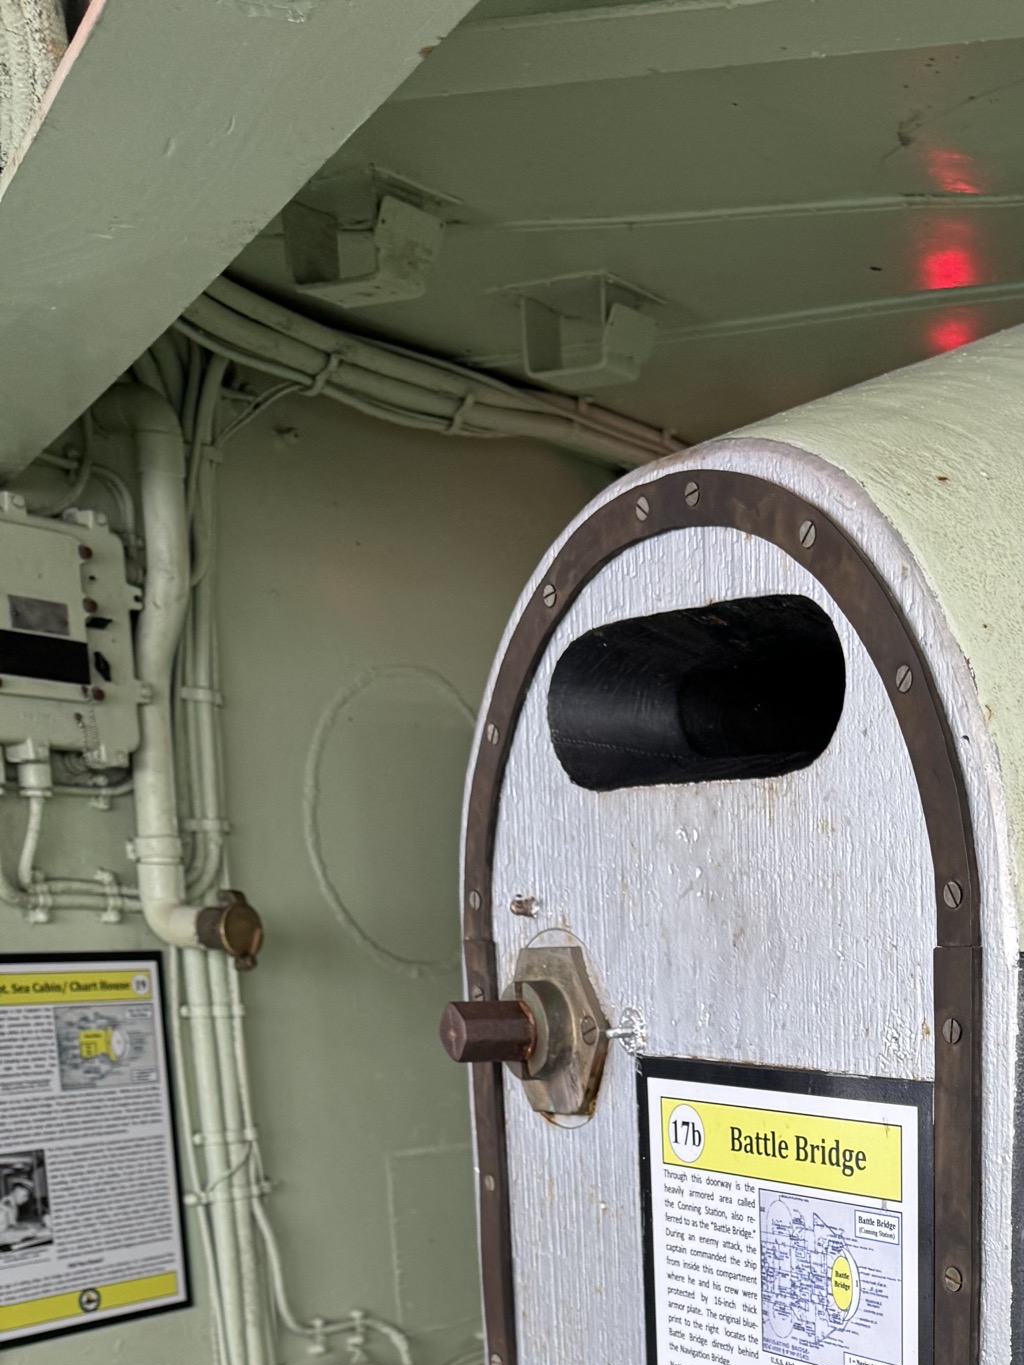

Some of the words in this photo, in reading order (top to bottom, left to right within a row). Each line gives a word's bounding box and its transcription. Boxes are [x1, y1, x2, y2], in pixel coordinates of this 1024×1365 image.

[672, 1119, 701, 1147] 17b
[729, 1126, 788, 1159] Battle
[794, 1134, 866, 1177] Bridge
[663, 1168, 687, 1183] Through
[690, 1173, 702, 1184] this
[705, 1175, 732, 1191] doorway
[743, 1182, 755, 1193] the
[663, 1183, 684, 1197] heavily
[688, 1189, 714, 1201] armored
[718, 1195, 732, 1204] area
[737, 1197, 755, 1209] called
[664, 1198, 674, 1209] the
[677, 1200, 702, 1216] Conning
[704, 1205, 728, 1220] Station,
[730, 1210, 743, 1222] also
[746, 1215, 756, 1224] re-
[664, 1212, 682, 1224] ferred
[698, 1219, 709, 1230] the
[858, 1215, 875, 1226] Battle
[876, 1218, 896, 1231] Bridge
[665, 1227, 685, 1241] During
[698, 1236, 719, 1248] enemy
[722, 1240, 742, 1253] attack,
[745, 1243, 757, 1255] the
[665, 1243, 687, 1254] captain
[689, 1248, 726, 1263] commanded
[729, 1255, 740, 1266] the
[743, 1258, 757, 1271] ship
[666, 1255, 680, 1267] from
[682, 1259, 700, 1272] inside
[702, 1264, 714, 1275] this
[715, 1268, 757, 1285] compartment
[666, 1271, 685, 1283] where
[698, 1279, 709, 1289] and
[712, 1280, 721, 1291] his
[723, 1285, 739, 1295] crew
[741, 1289, 757, 1300] were
[834, 1270, 849, 1280] Battle
[834, 1280, 850, 1291] Bridge
[667, 1286, 695, 1299] protected
[714, 1295, 736, 1309] 16-inch
[741, 1302, 757, 1314] thick
[667, 1300, 685, 1311] armor
[686, 1304, 703, 1316] plate.
[705, 1308, 717, 1320] The
[718, 1312, 741, 1325] original
[742, 1317, 758, 1330] blue-
[668, 1314, 682, 1325] print
[692, 1320, 703, 1330] the
[705, 1323, 719, 1335] right
[723, 1326, 746, 1341] locates
[747, 1333, 758, 1345] the
[668, 1327, 685, 1340] Battle
[688, 1332, 708, 1347] Bridge
[711, 1338, 734, 1354] directly
[737, 1344, 759, 1359] behind
[668, 1342, 678, 1352] the
[679, 1344, 710, 1360] Navigation
